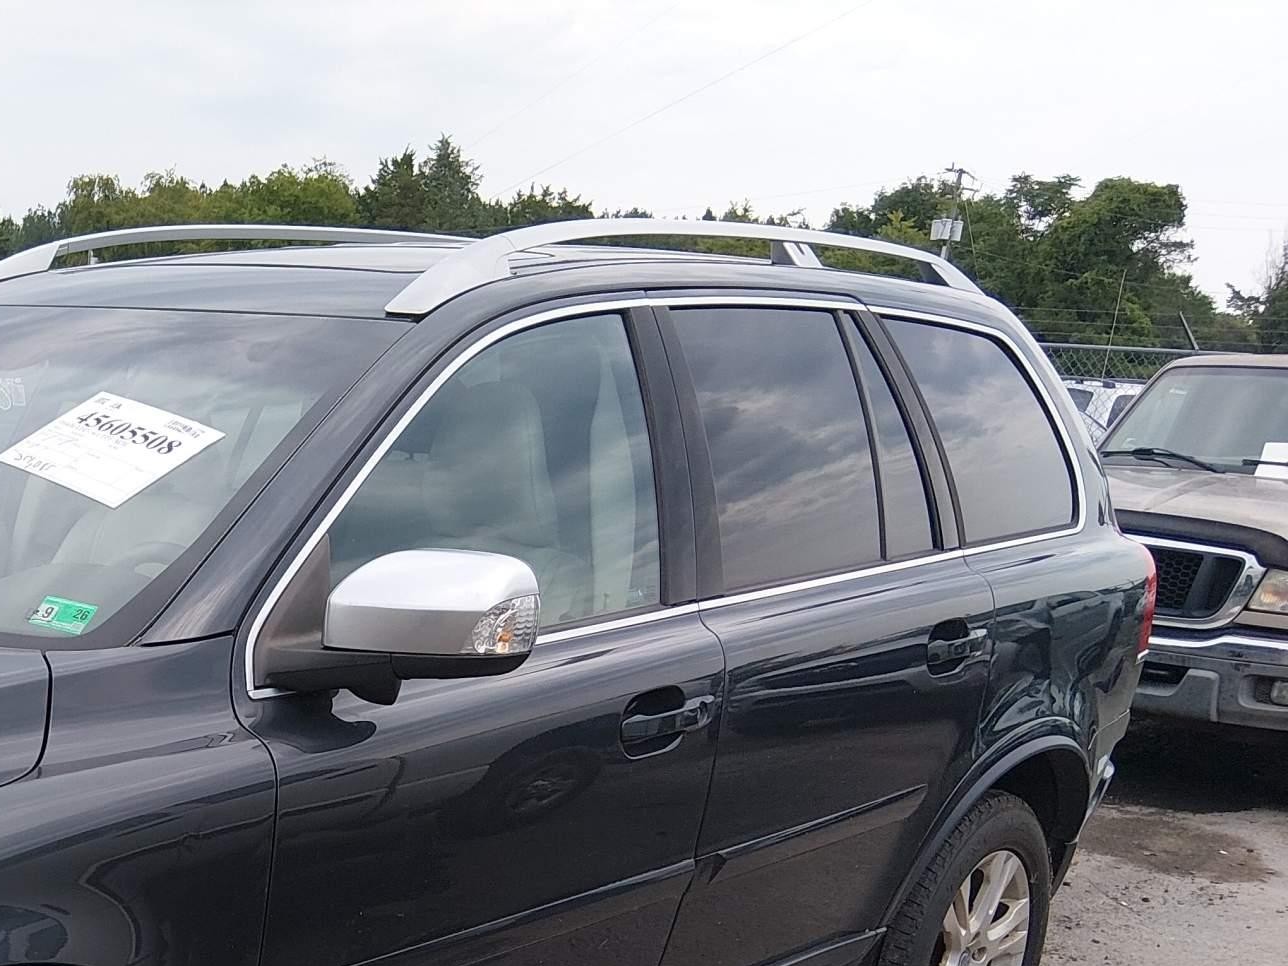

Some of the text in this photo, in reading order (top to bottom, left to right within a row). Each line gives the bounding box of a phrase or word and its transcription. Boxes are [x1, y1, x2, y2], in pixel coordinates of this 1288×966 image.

[76, 411, 183, 455] 45605508
[41, 606, 90, 621] 9 26
